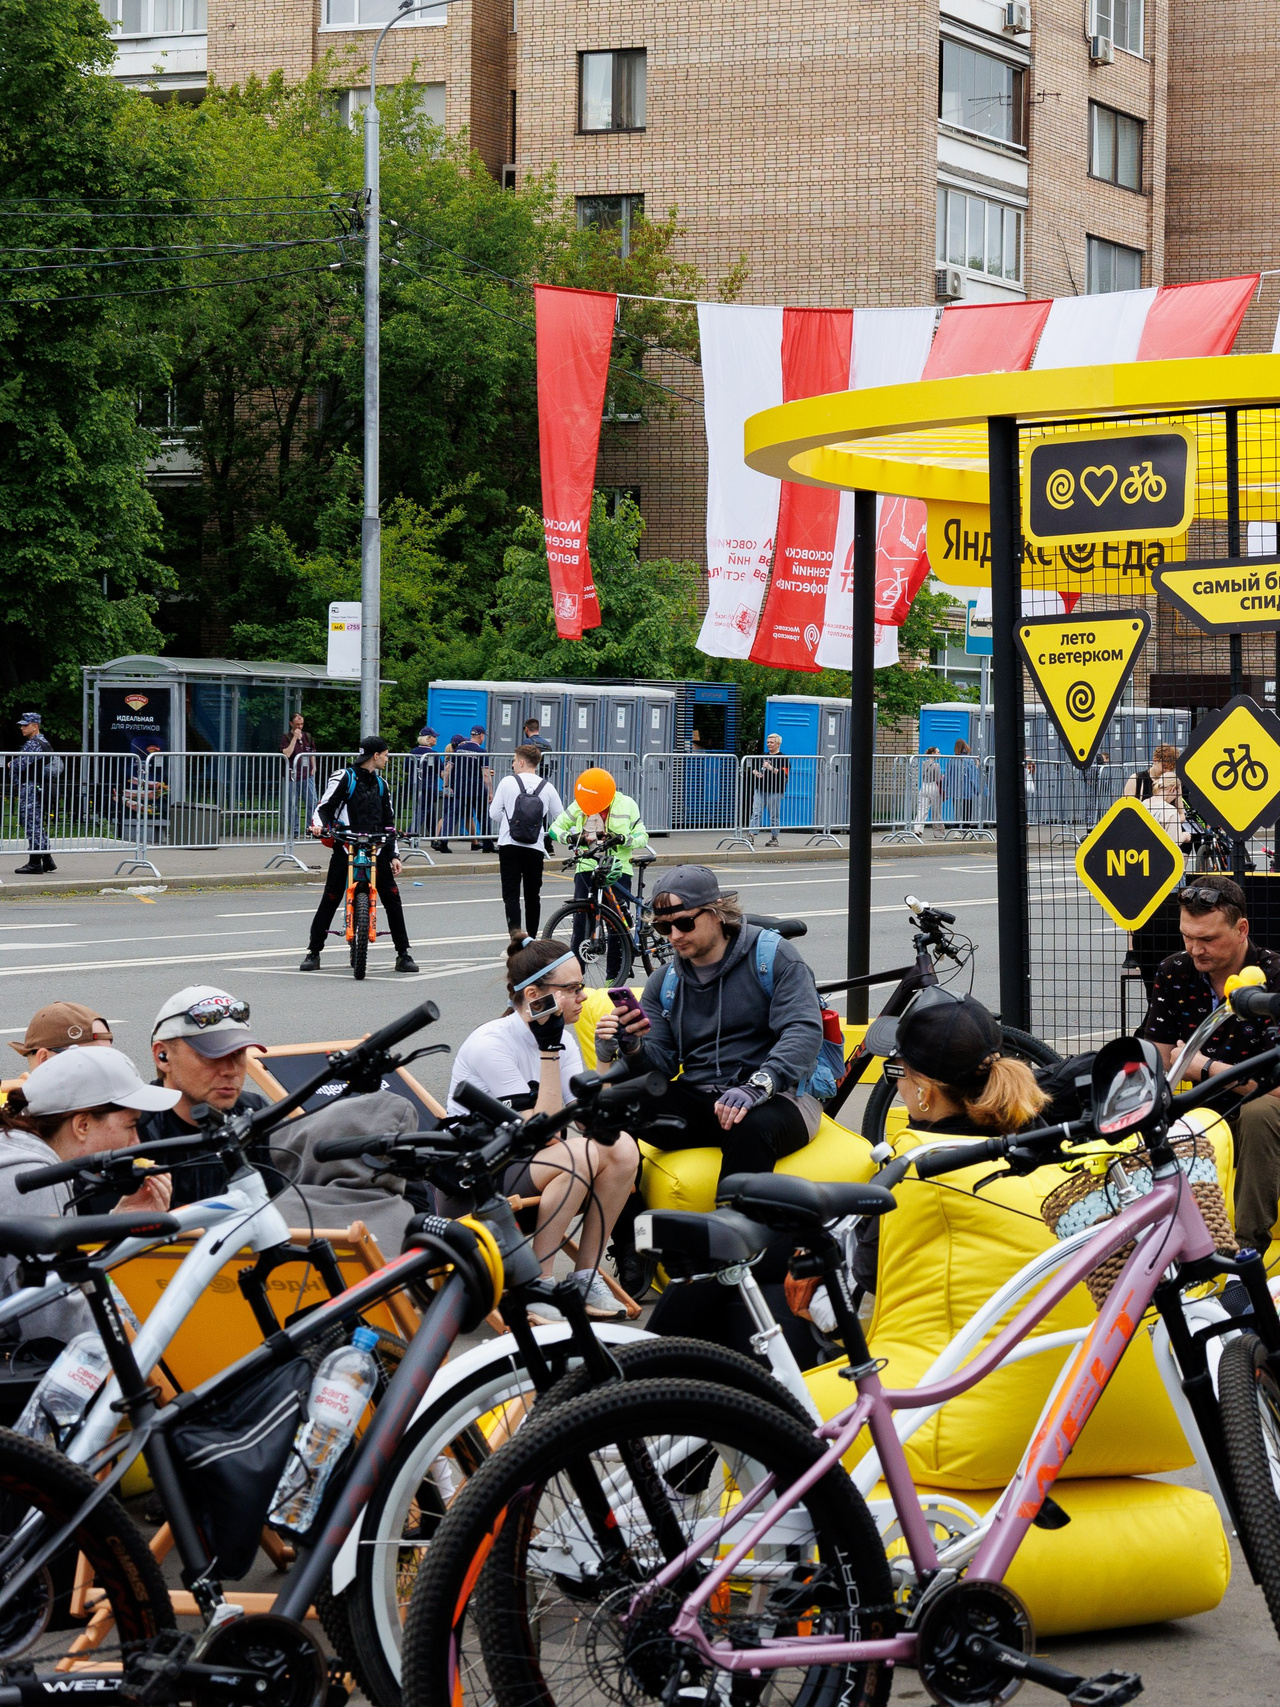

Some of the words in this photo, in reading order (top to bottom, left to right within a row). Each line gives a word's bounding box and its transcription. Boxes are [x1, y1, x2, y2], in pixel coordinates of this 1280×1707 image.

[942, 518, 1053, 569] Яндкс
[1192, 572, 1260, 597] самый
[1060, 631, 1096, 646] лето
[1038, 655, 1046, 666] с
[1049, 648, 1124, 669] ветерком
[116, 715, 154, 723] ИДЕАЛЬНАЯ
[125, 723, 161, 731] РУЛЕТИКОВ
[103, 1297, 125, 1345] WELT
[1015, 1288, 1136, 1519] WELT
[43, 1679, 124, 1694] WELT
